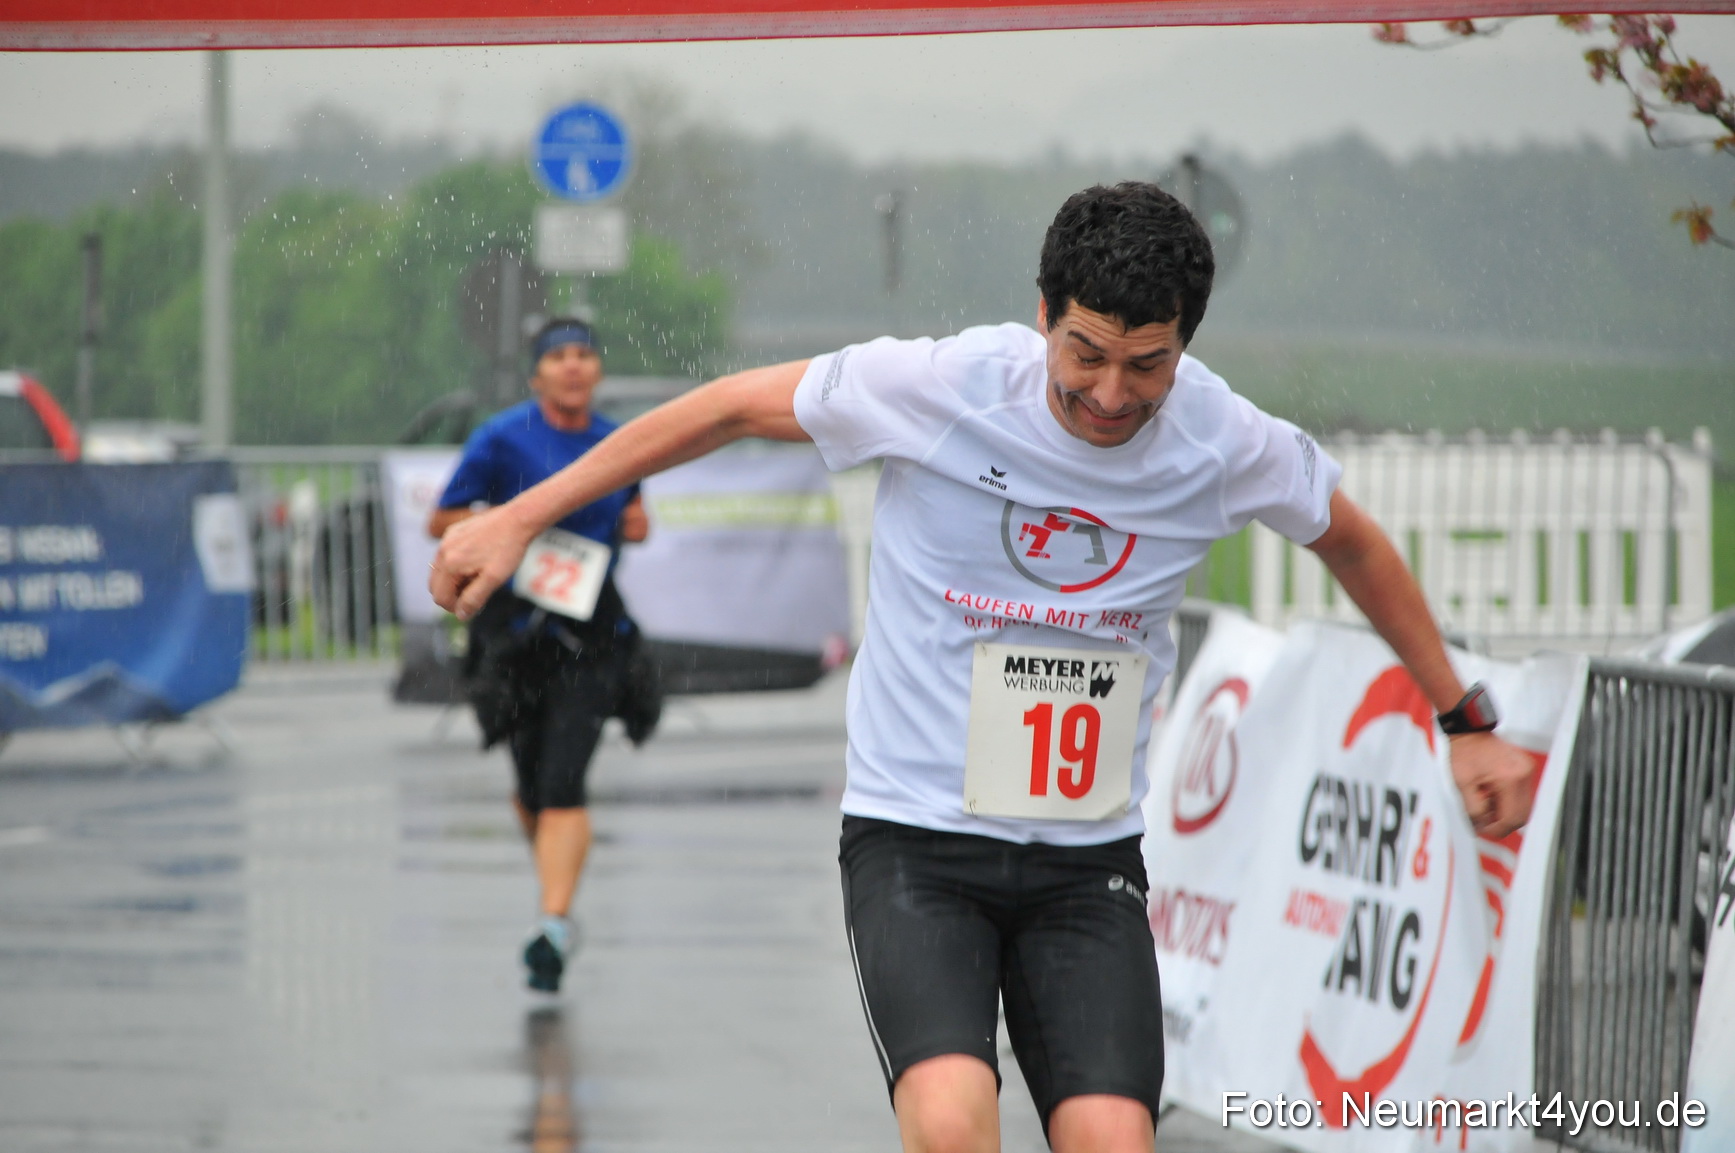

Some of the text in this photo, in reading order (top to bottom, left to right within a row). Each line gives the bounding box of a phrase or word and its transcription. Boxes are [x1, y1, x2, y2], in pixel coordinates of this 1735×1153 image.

[978, 475, 1008, 492] erima
[529, 551, 582, 603] 22
[944, 588, 1034, 620] LAUFEN
[1045, 607, 1089, 630] MIT
[1004, 655, 1085, 679] MEYER
[1003, 675, 1085, 695] WERBUNG
[1023, 701, 1102, 800] 19
